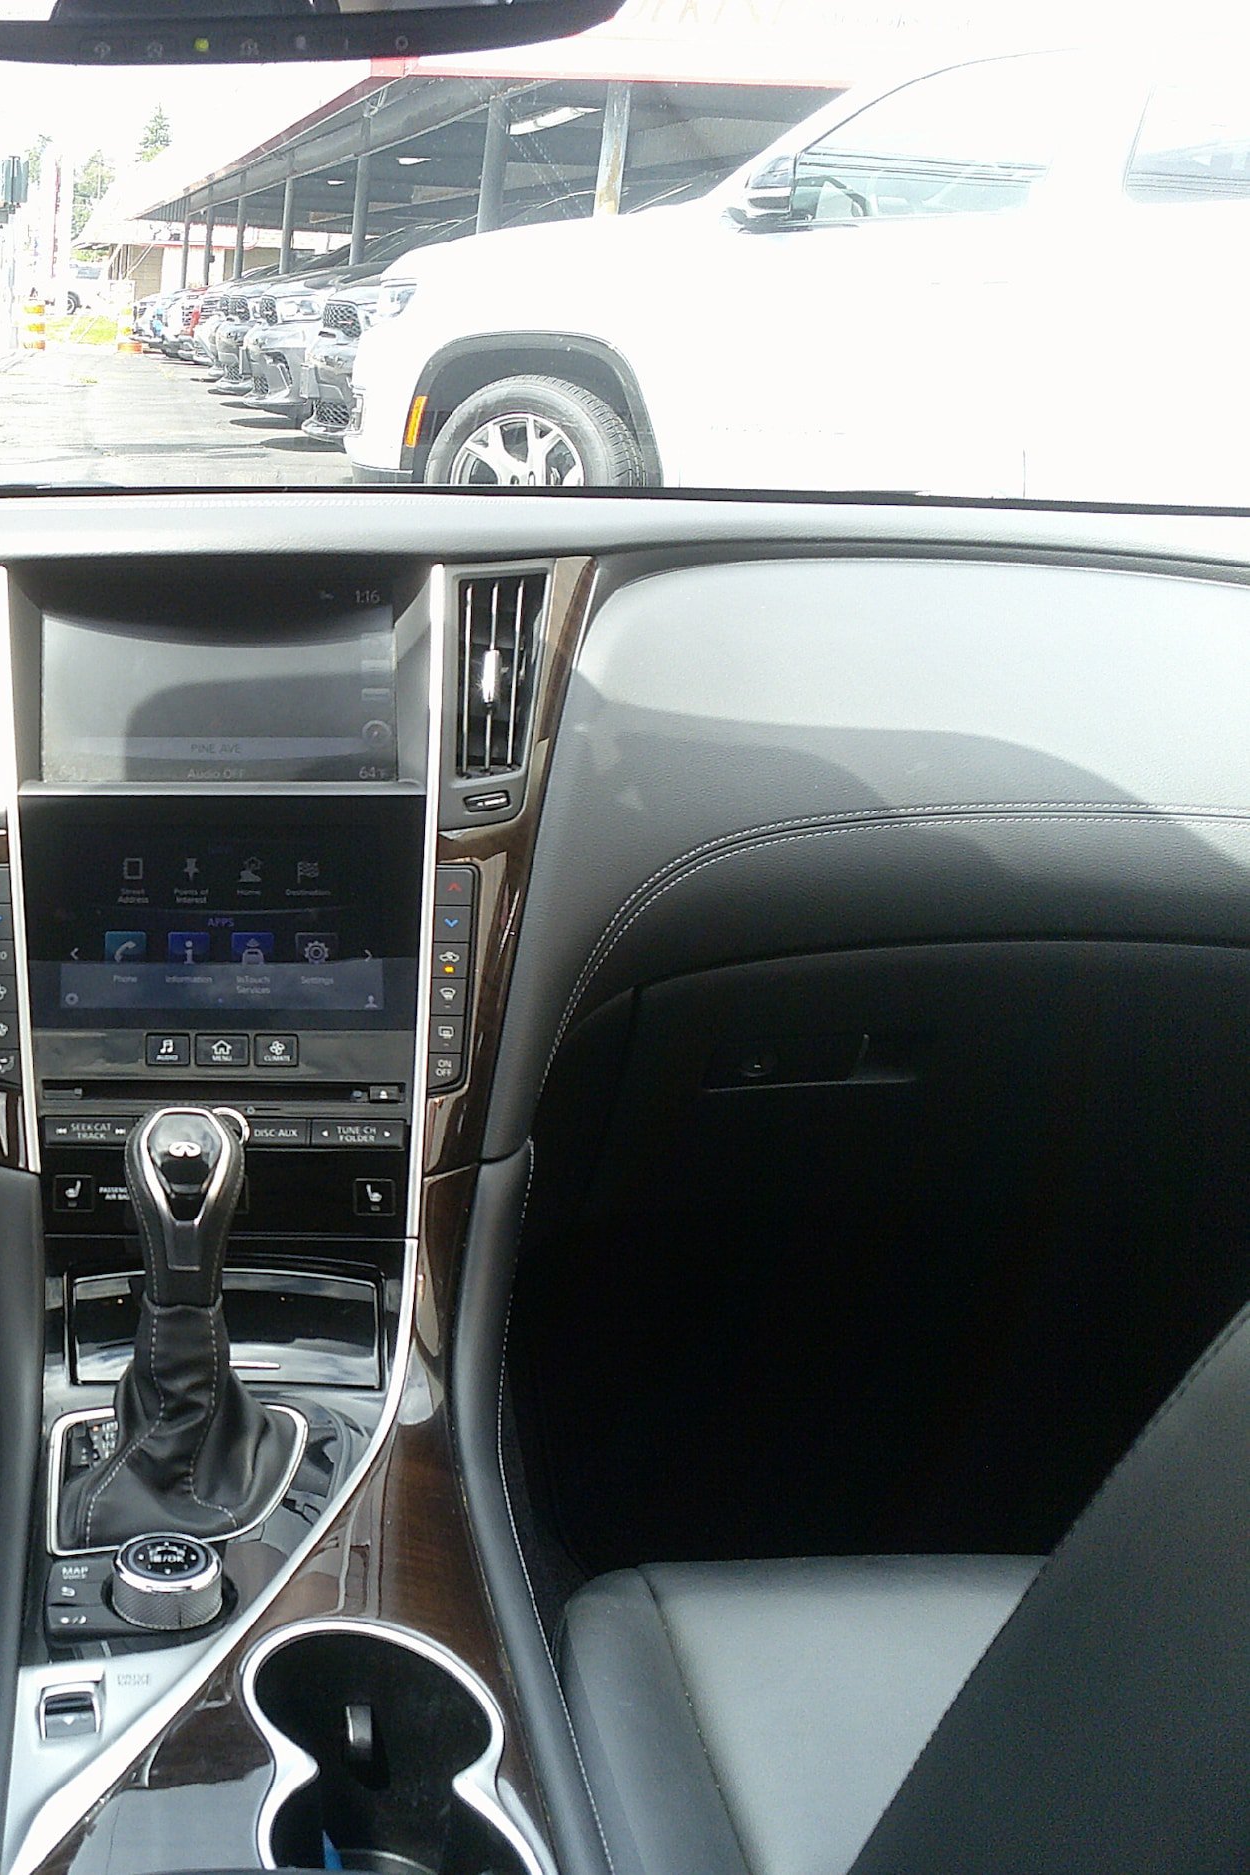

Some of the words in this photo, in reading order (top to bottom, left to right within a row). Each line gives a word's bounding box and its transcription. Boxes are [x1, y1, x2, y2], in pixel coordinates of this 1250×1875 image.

[354, 589, 381, 604] 1:16
[190, 743, 215, 754] PINE
[218, 743, 241, 754] AVE
[207, 916, 235, 928] APPS
[113, 975, 138, 983] Phone
[165, 975, 213, 983] Information
[300, 975, 334, 986] Settings
[437, 1059, 452, 1068] ON
[435, 1068, 452, 1077] OFF
[77, 1132, 106, 1140] TRACK
[339, 1134, 375, 1142] FOLDER
[61, 1565, 89, 1575] MAP
